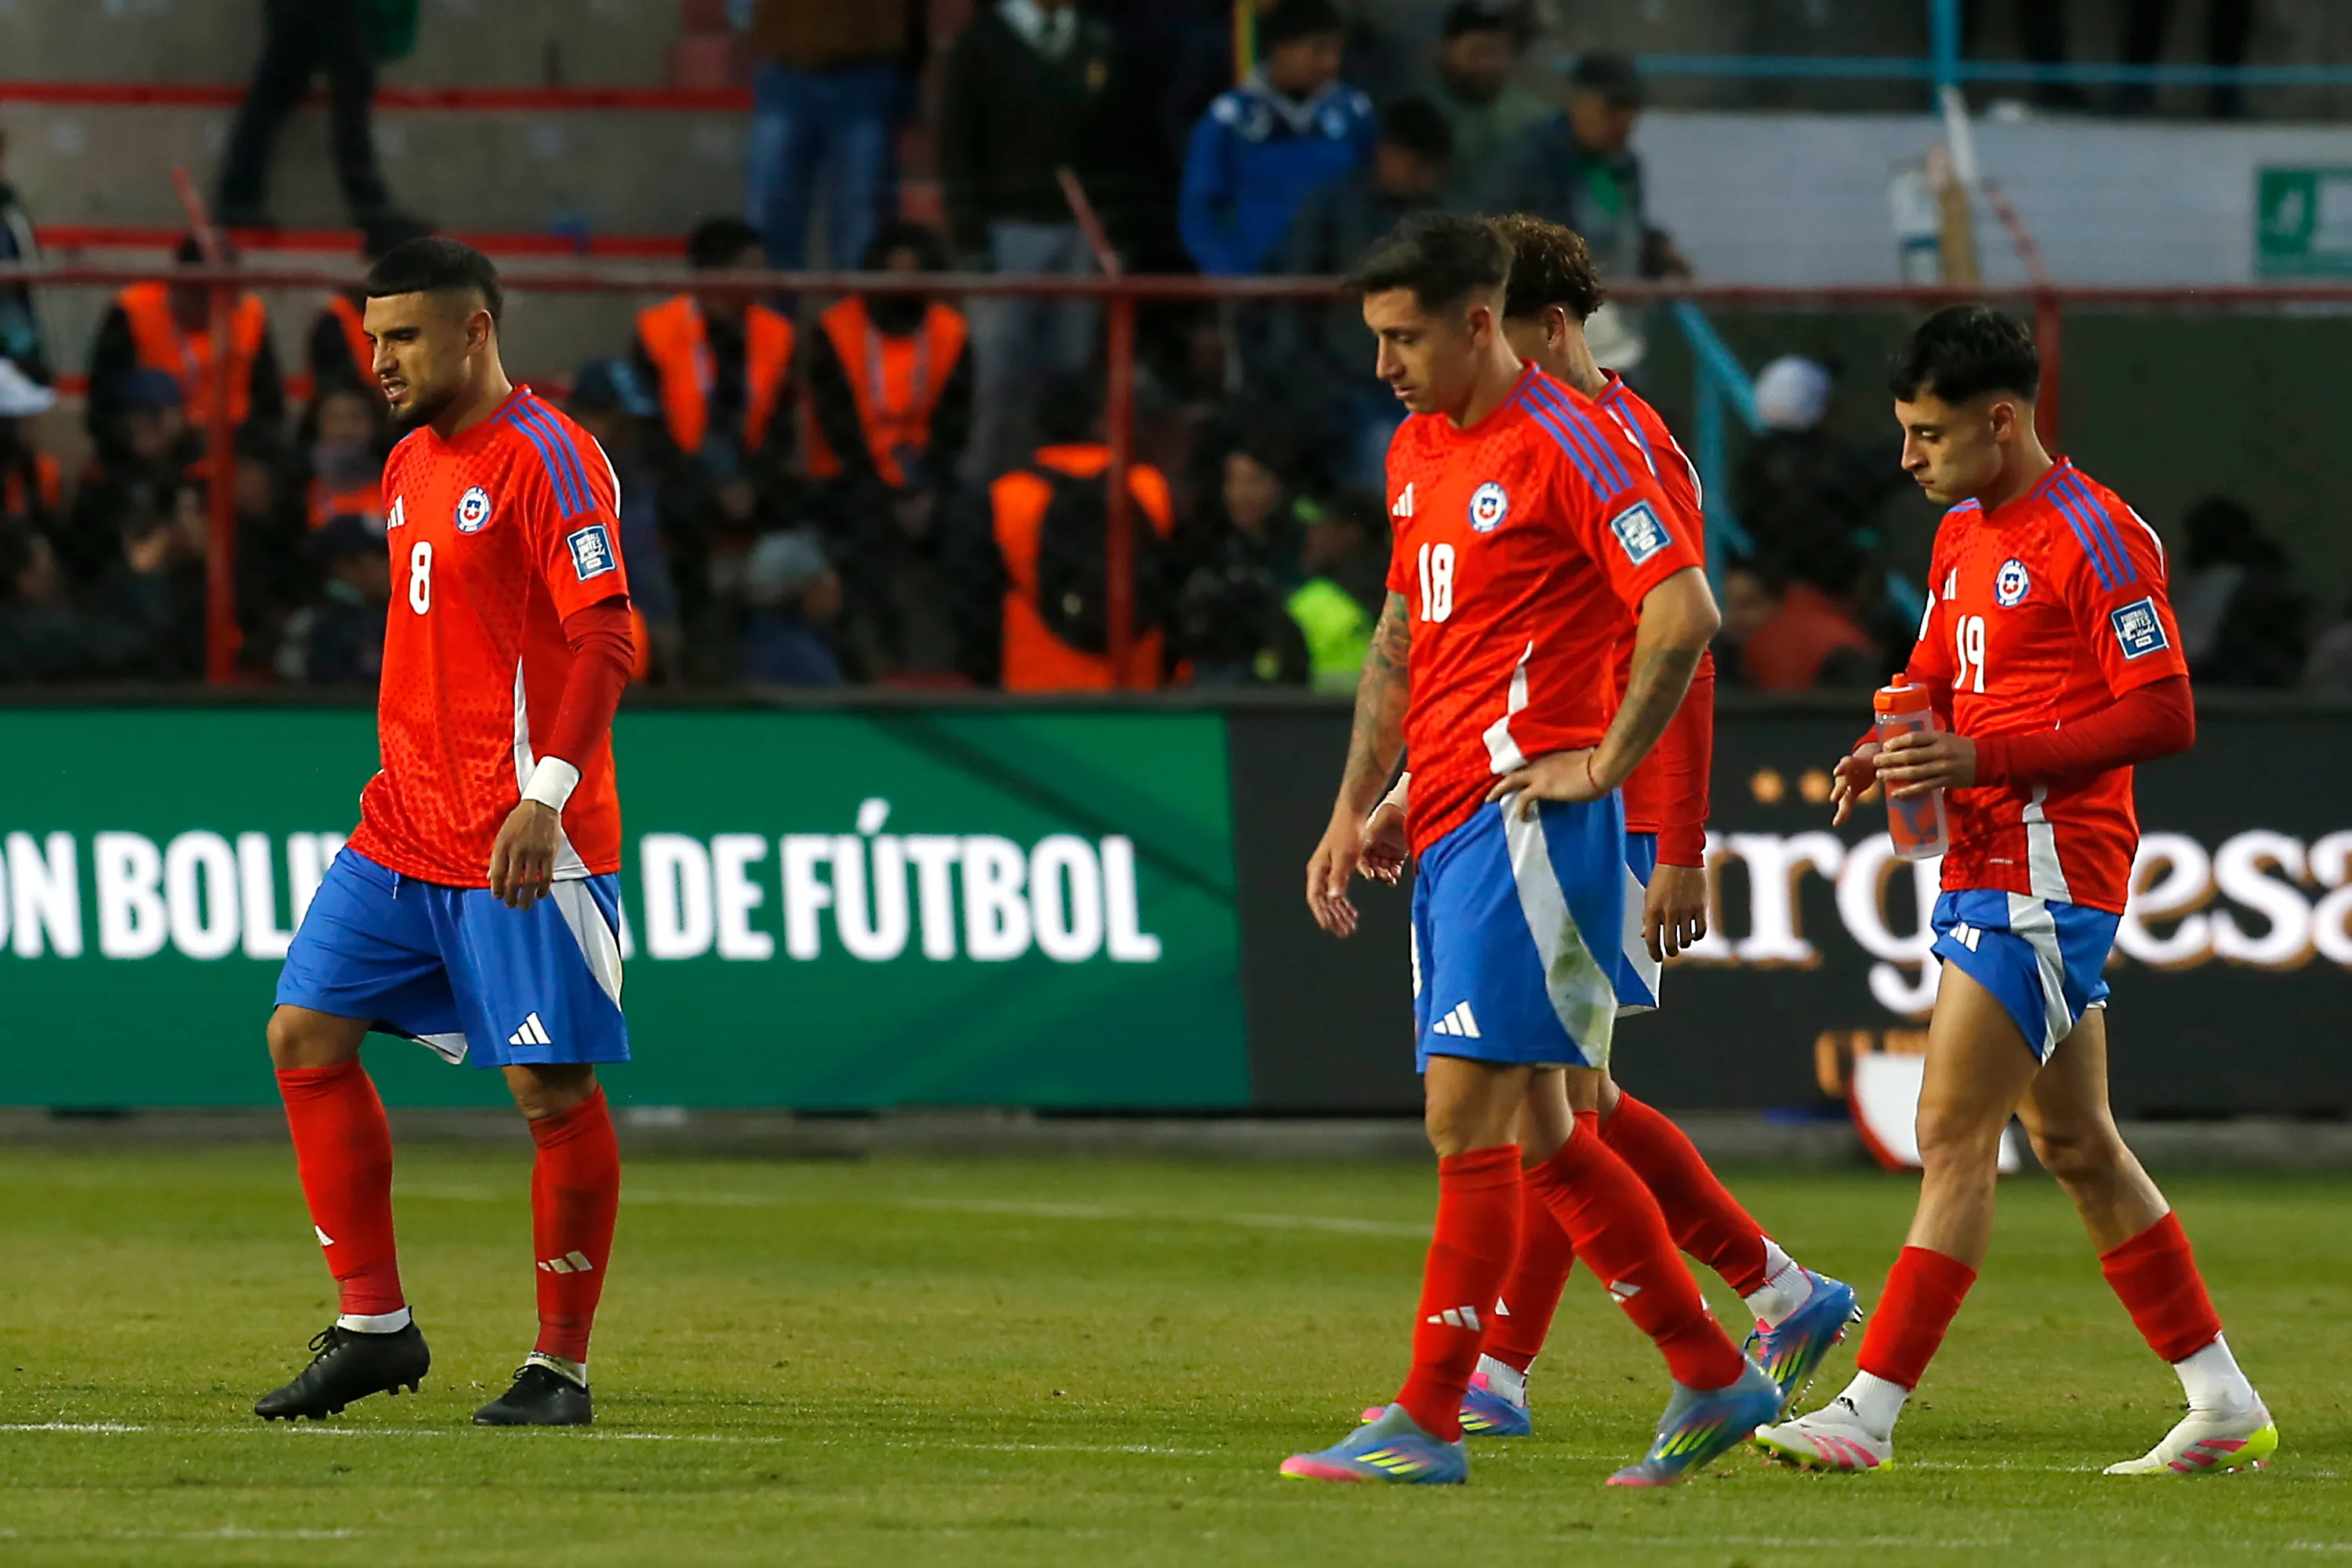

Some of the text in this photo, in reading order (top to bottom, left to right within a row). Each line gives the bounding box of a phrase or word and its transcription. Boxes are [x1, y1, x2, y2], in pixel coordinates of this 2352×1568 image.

[408, 540, 432, 615] 8
[1418, 543, 1455, 623] 18
[1954, 614, 1986, 693] 19
[0, 830, 84, 959] N
[640, 832, 775, 961] DE
[780, 797, 1162, 964] FÚTBOL
